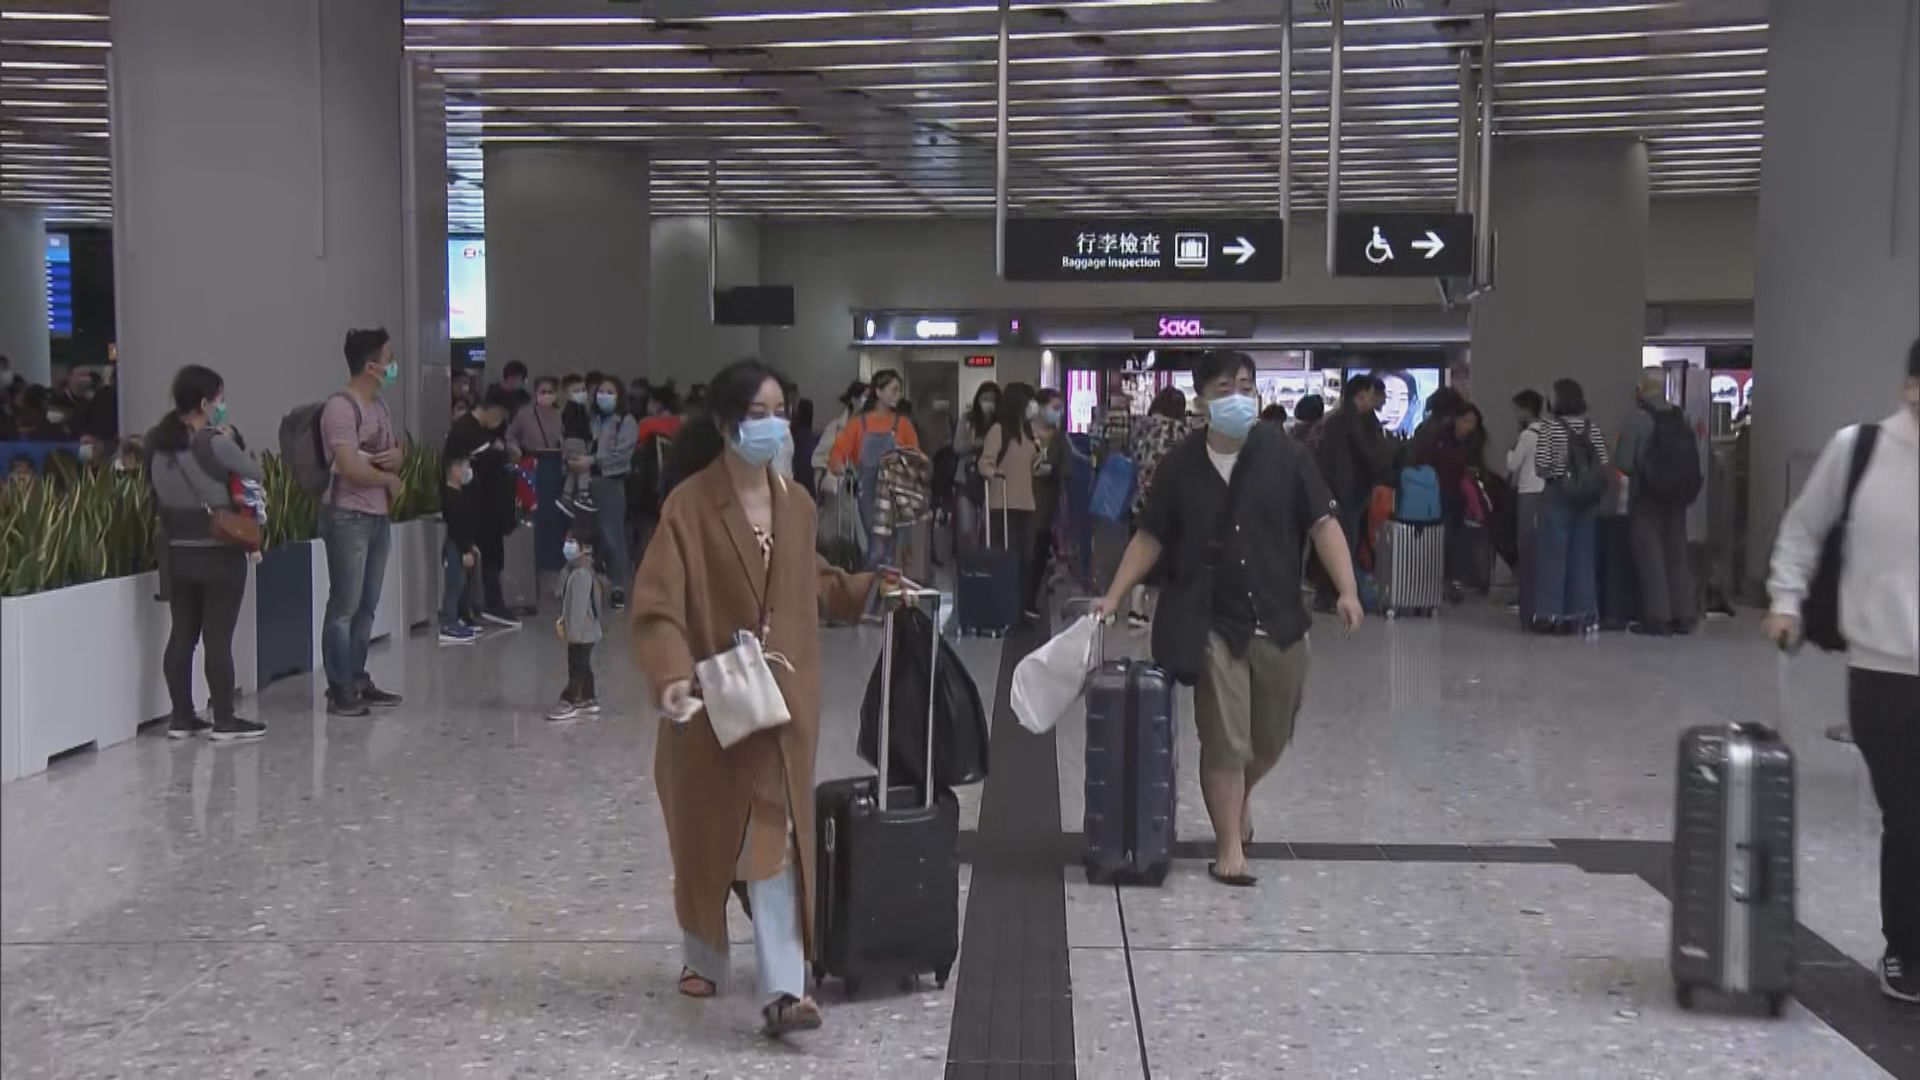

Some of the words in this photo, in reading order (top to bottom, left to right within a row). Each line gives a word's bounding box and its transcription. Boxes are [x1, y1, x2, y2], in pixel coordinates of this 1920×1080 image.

[1077, 232, 1160, 254] 行李檢查
[1062, 256, 1106, 269] Baggage
[1109, 256, 1160, 269] Inspection
